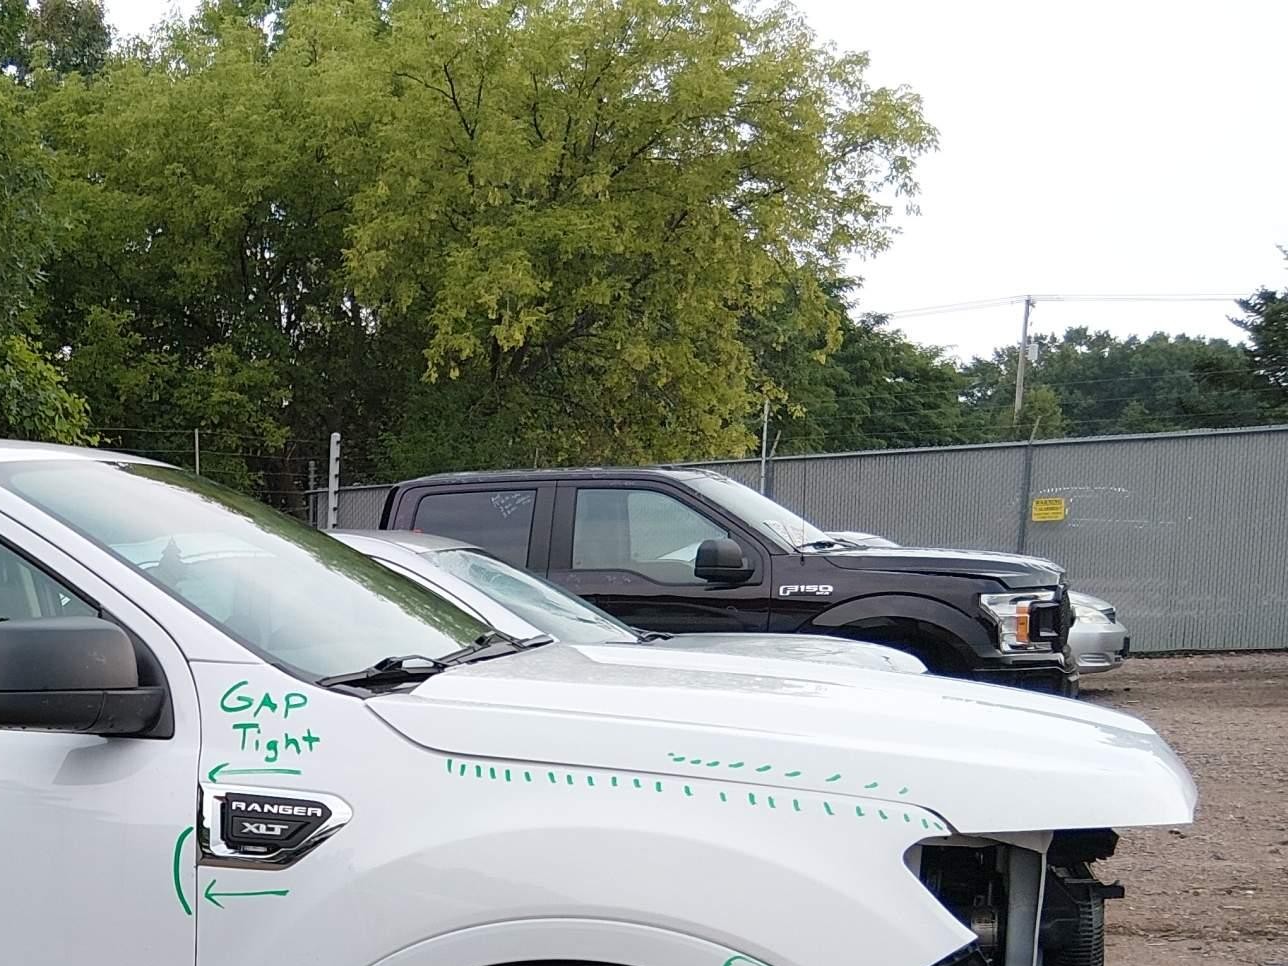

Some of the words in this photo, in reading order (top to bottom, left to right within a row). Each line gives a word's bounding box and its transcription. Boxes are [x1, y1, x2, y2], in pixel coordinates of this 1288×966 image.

[220, 680, 308, 718] GAP
[232, 723, 320, 762] Tight
[231, 801, 322, 817] RANGER
[241, 822, 289, 835] XLT
